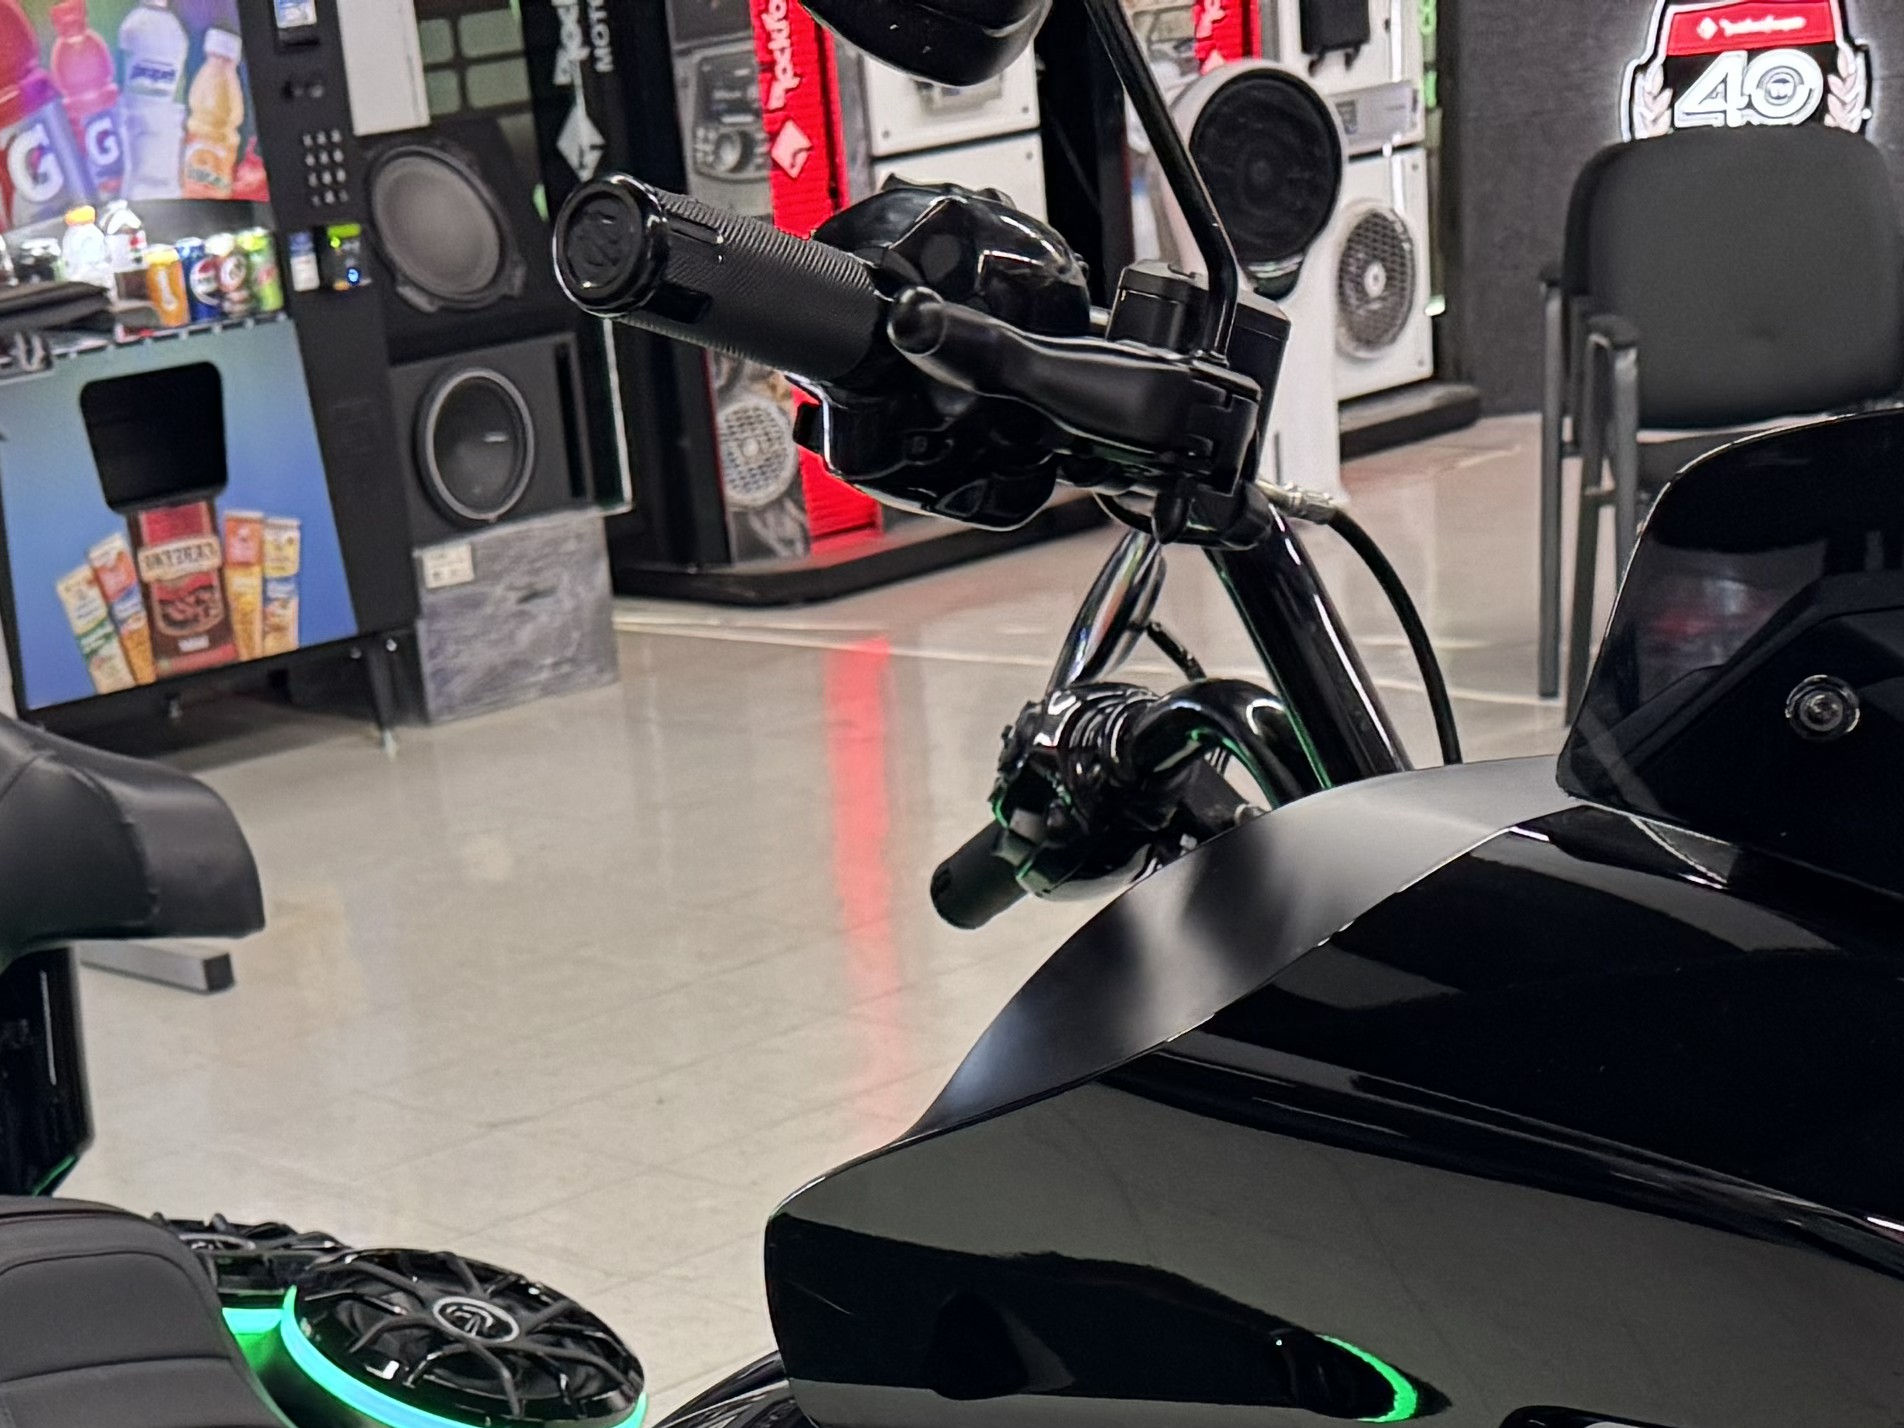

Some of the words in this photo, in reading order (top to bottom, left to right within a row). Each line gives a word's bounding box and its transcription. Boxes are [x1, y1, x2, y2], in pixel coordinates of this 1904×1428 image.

[588, 0, 614, 72] MOT
[1674, 49, 1824, 128] 40
[7, 122, 65, 203] G
[86, 116, 122, 166] G
